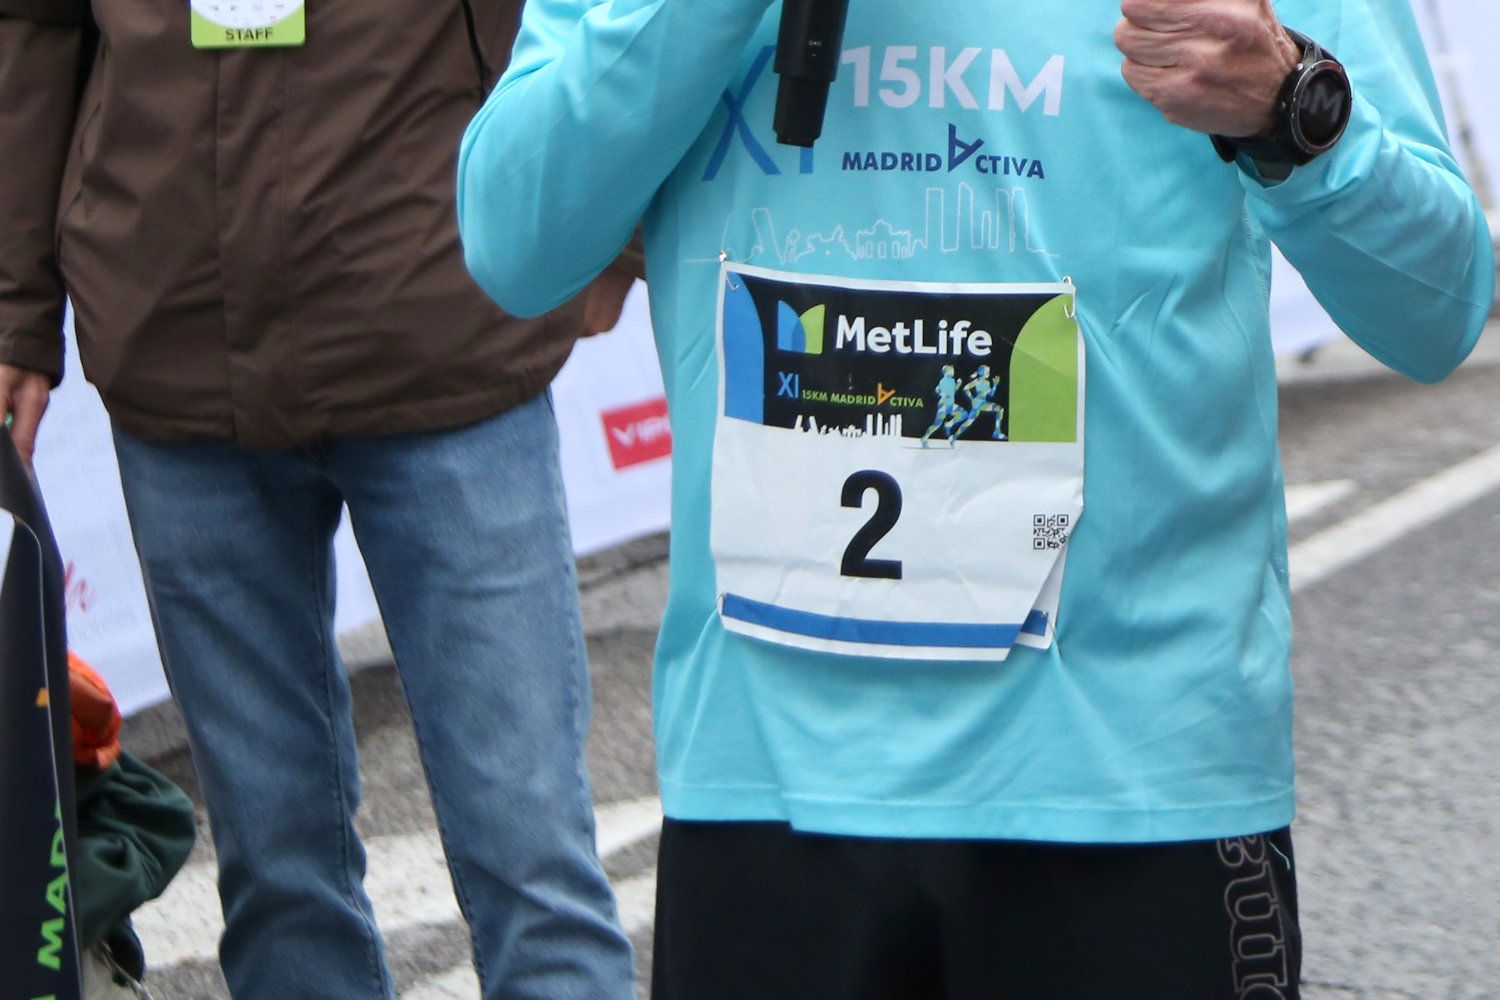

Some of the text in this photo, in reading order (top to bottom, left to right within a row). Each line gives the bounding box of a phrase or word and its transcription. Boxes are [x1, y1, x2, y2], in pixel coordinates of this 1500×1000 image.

[225, 28, 273, 41] STAFF
[841, 45, 1065, 116] 15KM
[836, 314, 993, 356] MetLife
[777, 371, 799, 399] XI
[802, 390, 828, 401] 15KM
[830, 393, 876, 406] MADRID
[840, 469, 903, 580] 2
